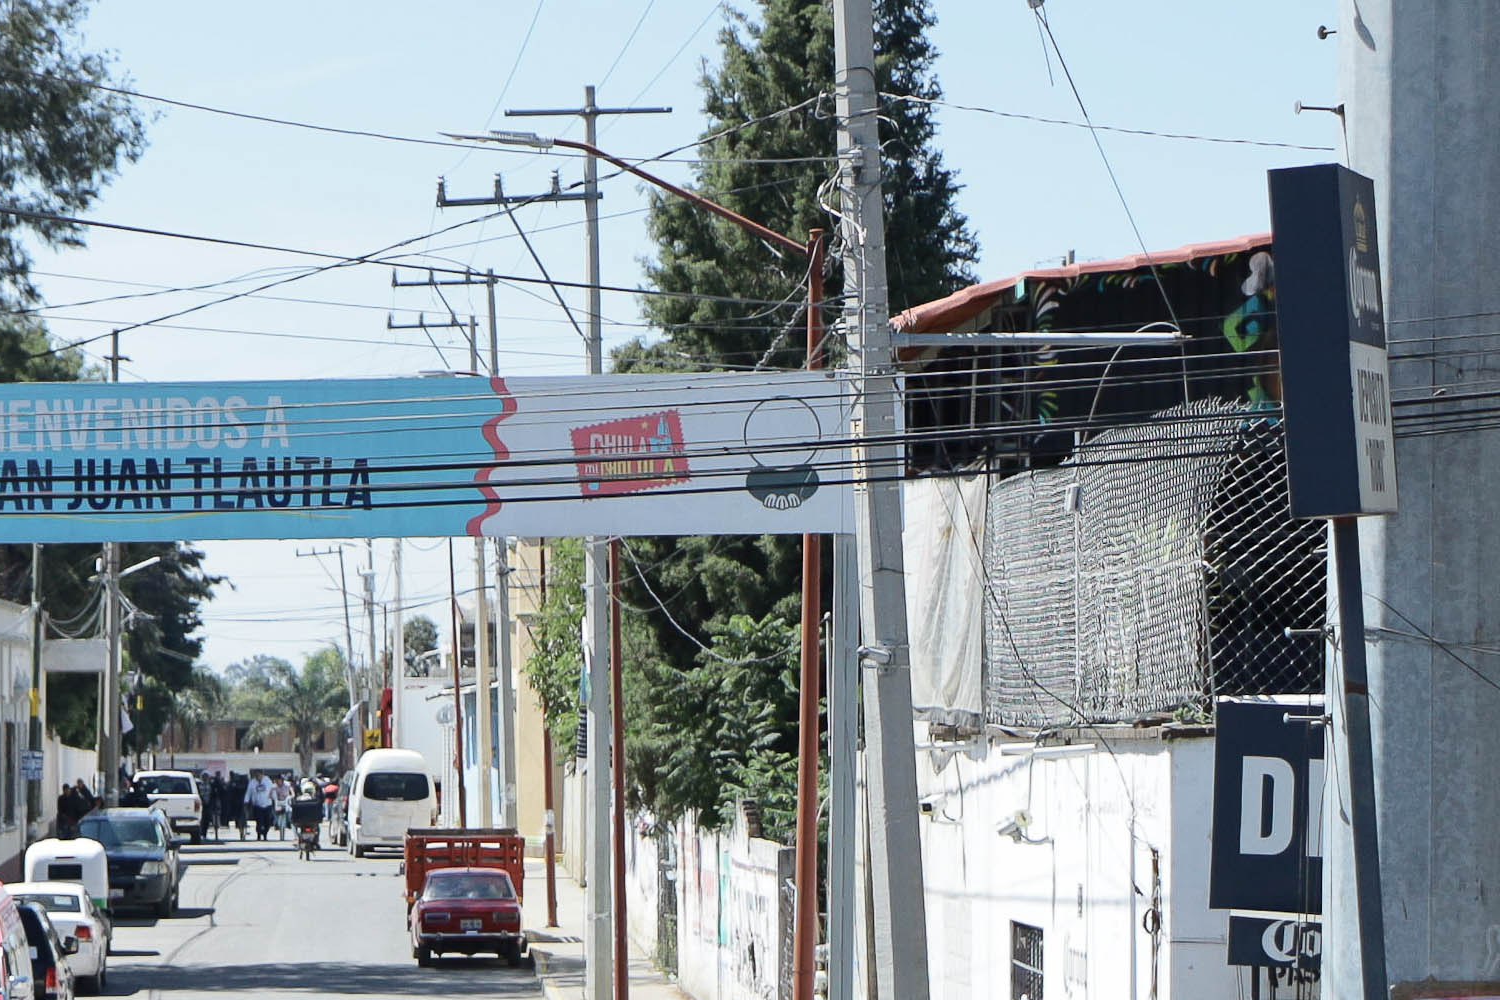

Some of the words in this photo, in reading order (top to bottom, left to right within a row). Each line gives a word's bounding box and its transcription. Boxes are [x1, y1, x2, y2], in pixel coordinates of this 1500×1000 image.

[260, 395, 290, 449] A
[67, 458, 172, 510] JUAN
[186, 456, 373, 511] TLAUTLA
